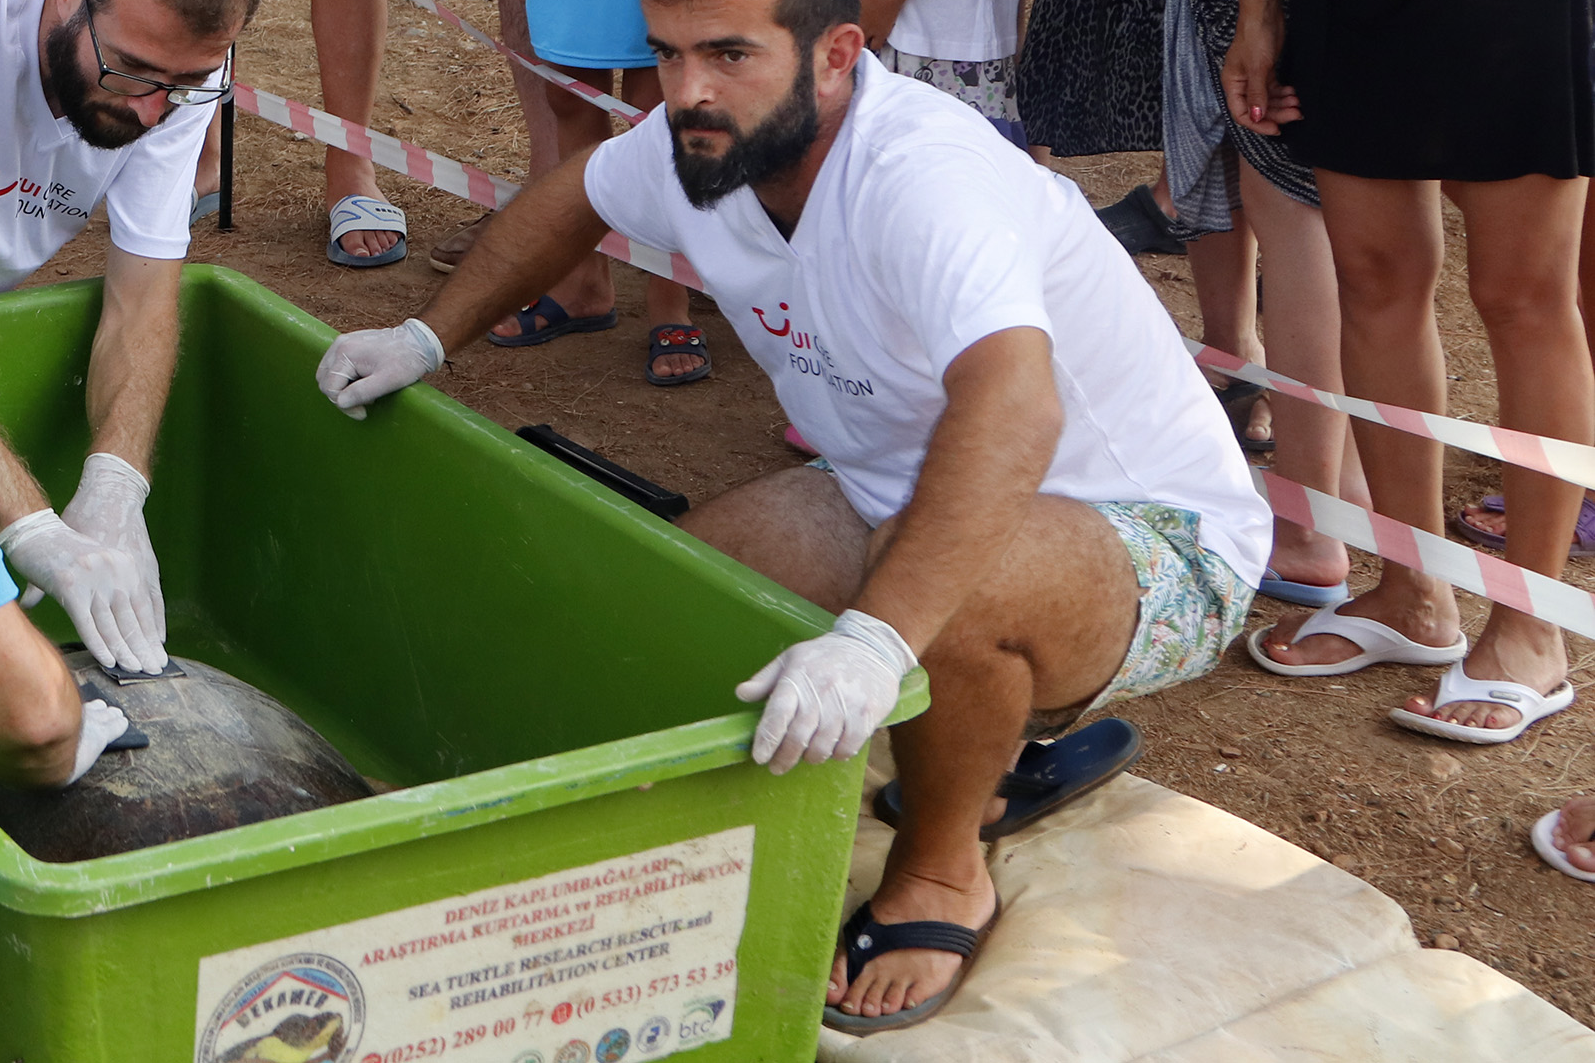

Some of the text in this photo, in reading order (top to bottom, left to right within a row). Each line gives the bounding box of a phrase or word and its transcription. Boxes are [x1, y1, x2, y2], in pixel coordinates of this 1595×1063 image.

[445, 857, 669, 925] DENİZ KAPLUMBAĞALARI
[359, 930, 467, 967] ARAŞTIRMA
[471, 904, 570, 938] KURTARMA
[408, 910, 713, 1002] SEA TURTLE RESEARCH RESCUE and
[512, 913, 595, 949] MERKEZİ
[449, 942, 670, 1011] REHABILITATION CENTER
[383, 1036, 446, 1063] (0252)
[452, 1024, 487, 1049] 289
[493, 1017, 516, 1038] 00
[522, 1009, 544, 1030] 77
[577, 996, 596, 1018] (0
[601, 985, 641, 1009] 533)
[647, 974, 679, 997] 573
[685, 966, 707, 987] 53
[712, 959, 735, 980] 39
